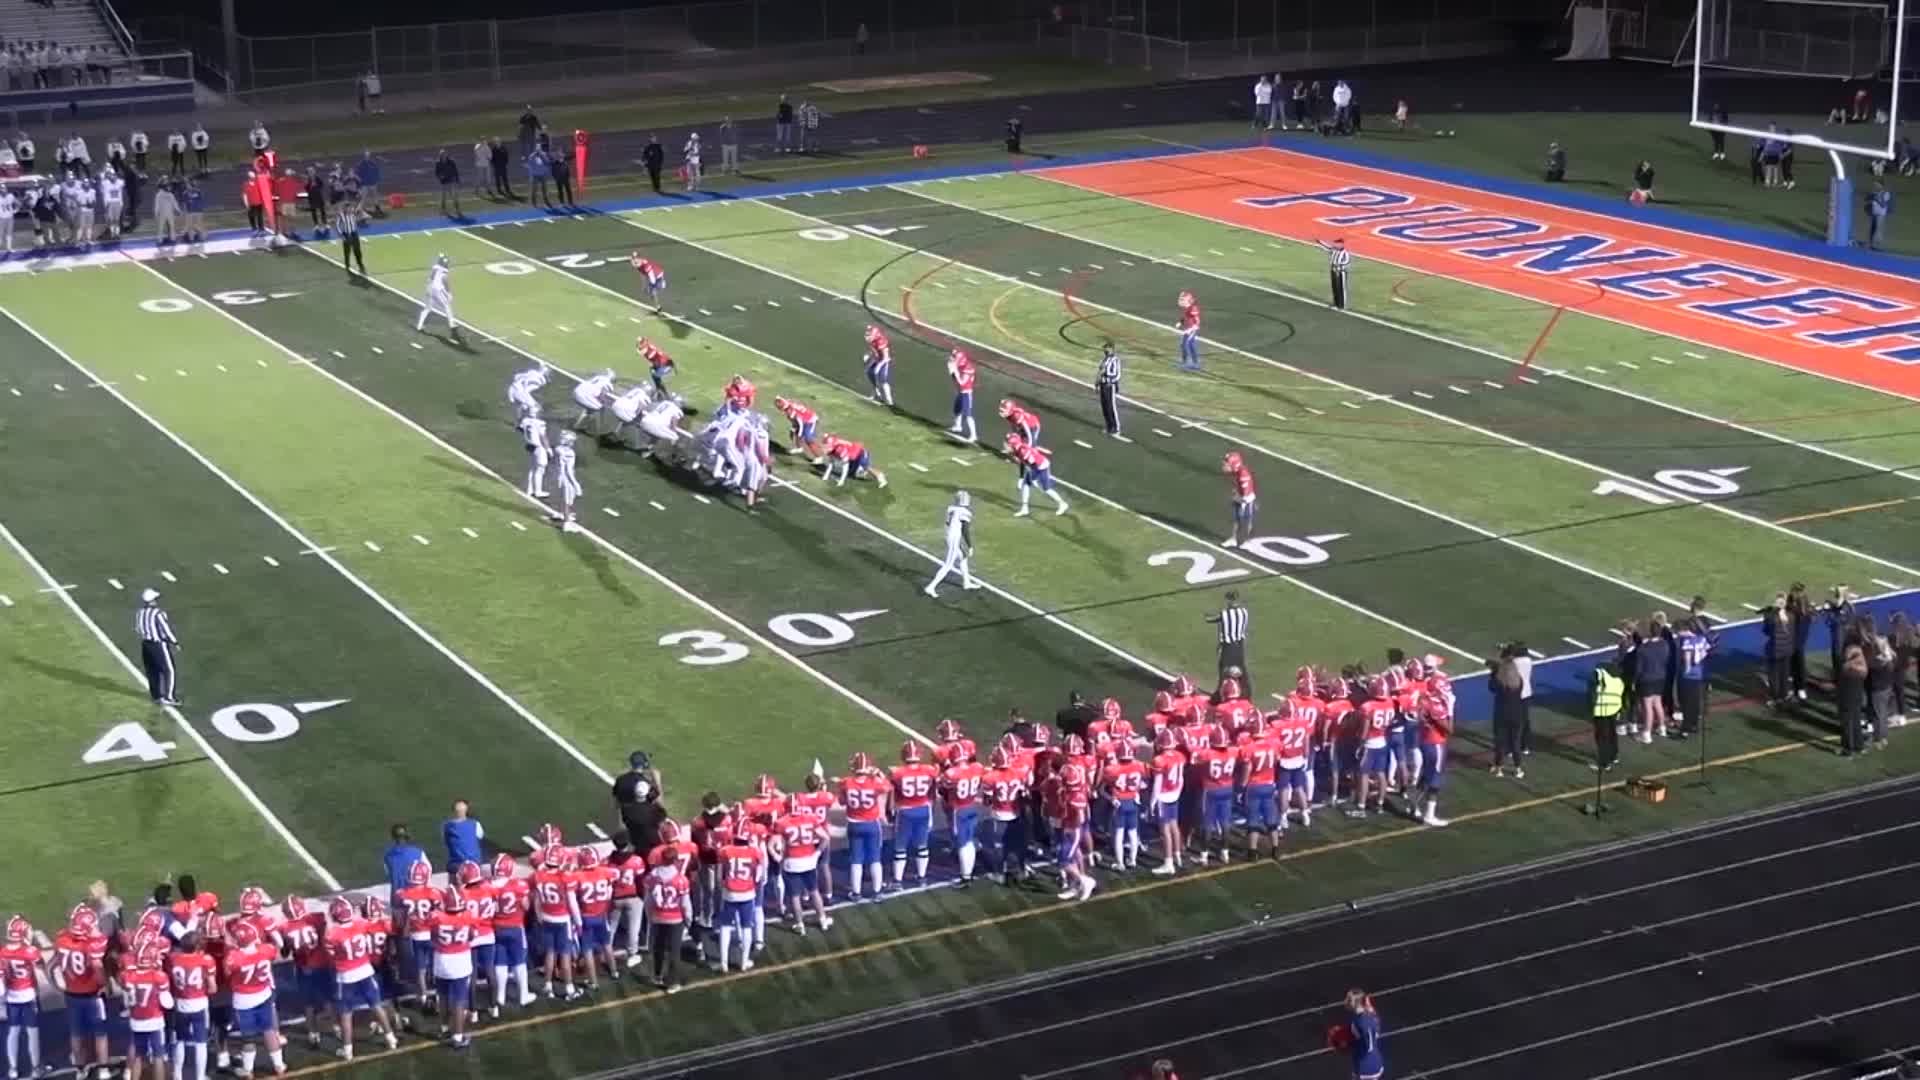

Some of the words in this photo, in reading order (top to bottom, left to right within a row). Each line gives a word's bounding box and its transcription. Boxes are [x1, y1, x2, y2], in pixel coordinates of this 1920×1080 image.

[1281, 727, 1306, 750] 22
[1210, 757, 1236, 778] 64
[1254, 750, 1276, 772] 71
[901, 775, 931, 798] 55
[1115, 772, 1142, 792] 43
[846, 788, 876, 810] 65
[784, 823, 814, 846] 25
[728, 857, 753, 881] 15
[581, 880, 609, 904] 29
[438, 925, 470, 945] 54
[58, 947, 86, 976] 78
[241, 959, 272, 985] 73
